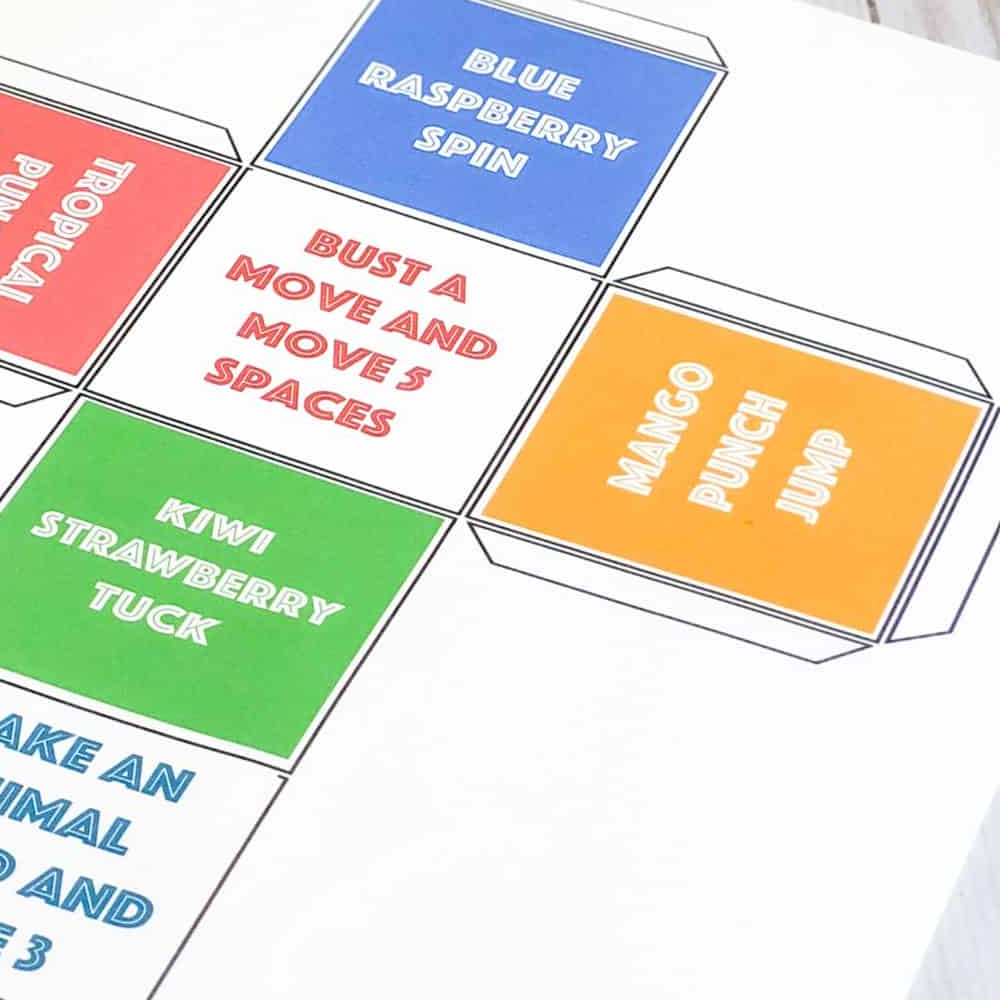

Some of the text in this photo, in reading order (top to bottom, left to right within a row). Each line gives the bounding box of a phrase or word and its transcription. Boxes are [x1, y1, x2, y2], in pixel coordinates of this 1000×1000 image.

[357, 60, 638, 162] RASPBERRY
[461, 47, 582, 101] BLUE
[413, 126, 531, 179] SPIN
[303, 228, 469, 304] BUST A
[224, 253, 499, 361] MOVE AND
[235, 311, 433, 392] MOVE 5
[203, 356, 397, 438] SPACES
[606, 361, 715, 497] MANGO
[687, 389, 789, 514] PUNCH
[775, 428, 854, 526] JUMP
[154, 497, 277, 556] KIWI
[30, 510, 346, 626] STRAWBERRY
[88, 580, 224, 647] TUCK
[97, 753, 197, 804] AN
[15, 866, 155, 930] AND
[11, 933, 54, 973] 3
